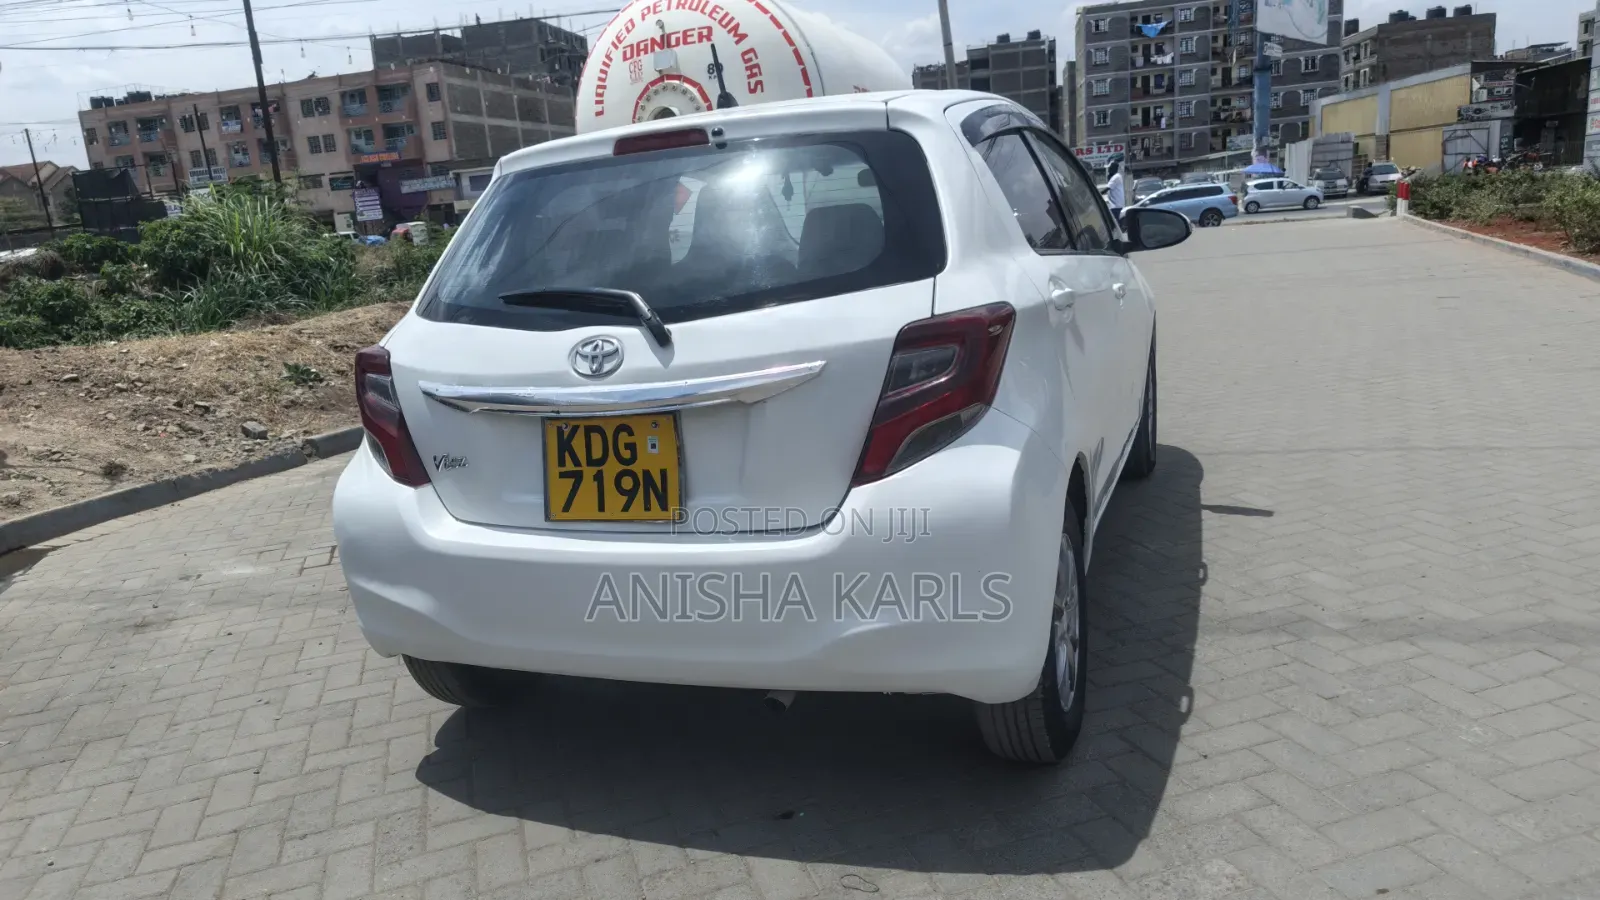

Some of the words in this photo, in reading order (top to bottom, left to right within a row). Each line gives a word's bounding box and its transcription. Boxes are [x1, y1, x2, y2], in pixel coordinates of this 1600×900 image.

[595, 18, 636, 117] LIQUIFIED
[641, 0, 749, 46] PETROLEUM
[741, 47, 764, 94] GAS
[622, 25, 713, 62] DANGER
[1097, 144, 1124, 154] LTD
[556, 423, 639, 468] KDG
[558, 468, 669, 513] 719N
